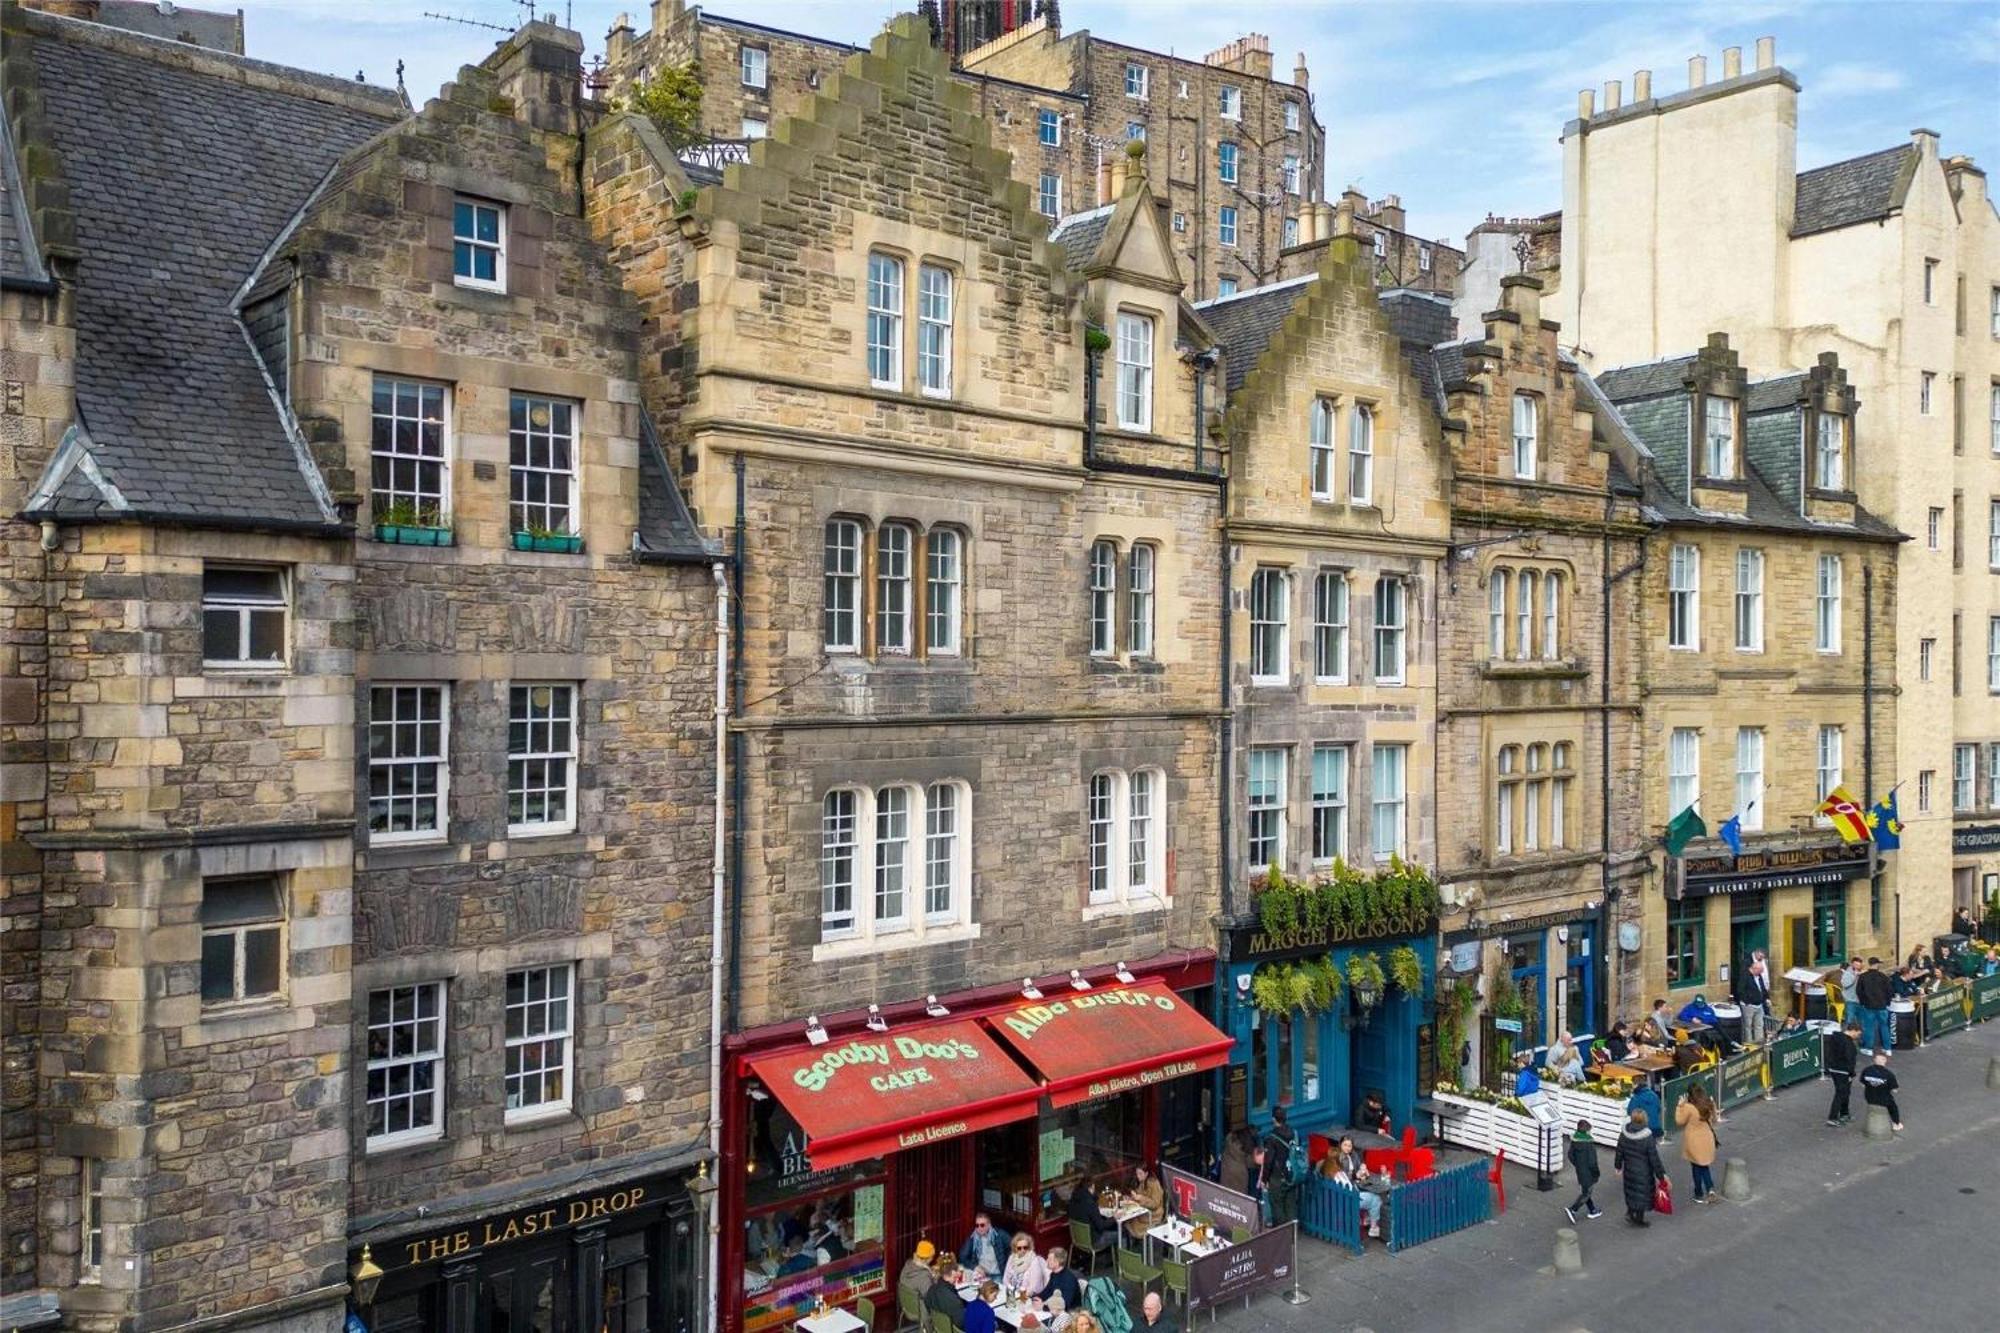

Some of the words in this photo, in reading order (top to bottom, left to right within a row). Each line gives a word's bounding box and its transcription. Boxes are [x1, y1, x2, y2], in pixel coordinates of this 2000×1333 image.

[1709, 883, 1748, 894] WELCOME
[1752, 881, 1762, 890] TO
[1767, 877, 1794, 889] BIDDY
[1798, 873, 1843, 885] MULLIGANS
[1249, 923, 1328, 955] MAGGIE
[1333, 912, 1429, 943] DICKSON'S
[793, 1042, 892, 1092] Scooby
[895, 1036, 980, 1061] Doo's
[872, 1068, 931, 1091] CAFE
[1088, 1083, 1109, 1098] Alba
[1109, 1077, 1141, 1092] Bistro,
[1140, 1071, 1163, 1085] Open
[1163, 1066, 1178, 1080] Till
[1178, 1061, 1199, 1075] Late
[900, 1127, 924, 1147] Late
[924, 1119, 967, 1140] Licence
[1174, 1178, 1197, 1217] T
[406, 1231, 471, 1265] THE
[484, 1208, 557, 1246] LAST
[568, 1187, 646, 1224] DROP
[1224, 1261, 1255, 1279] BISTRO
